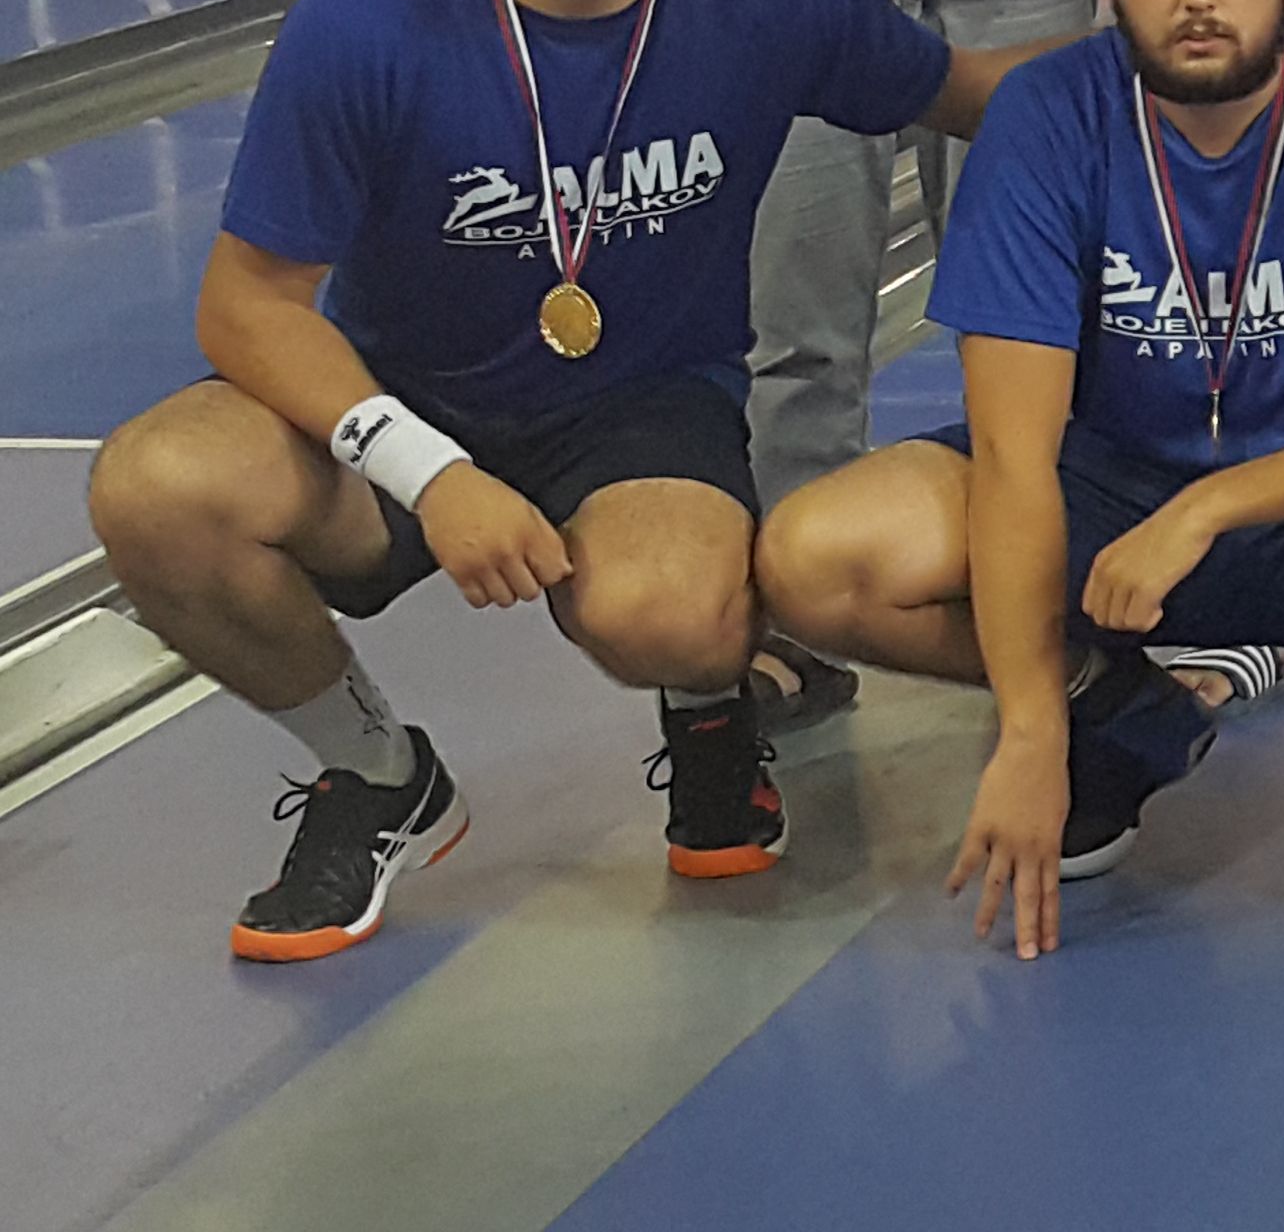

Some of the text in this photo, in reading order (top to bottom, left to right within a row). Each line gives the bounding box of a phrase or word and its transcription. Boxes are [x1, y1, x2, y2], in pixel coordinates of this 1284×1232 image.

[539, 131, 724, 220] ALMA
[464, 225, 545, 240] BOJ
[595, 176, 720, 224] LAKOV
[518, 217, 664, 260] ATIN
[1136, 338, 1277, 360] APAIN
